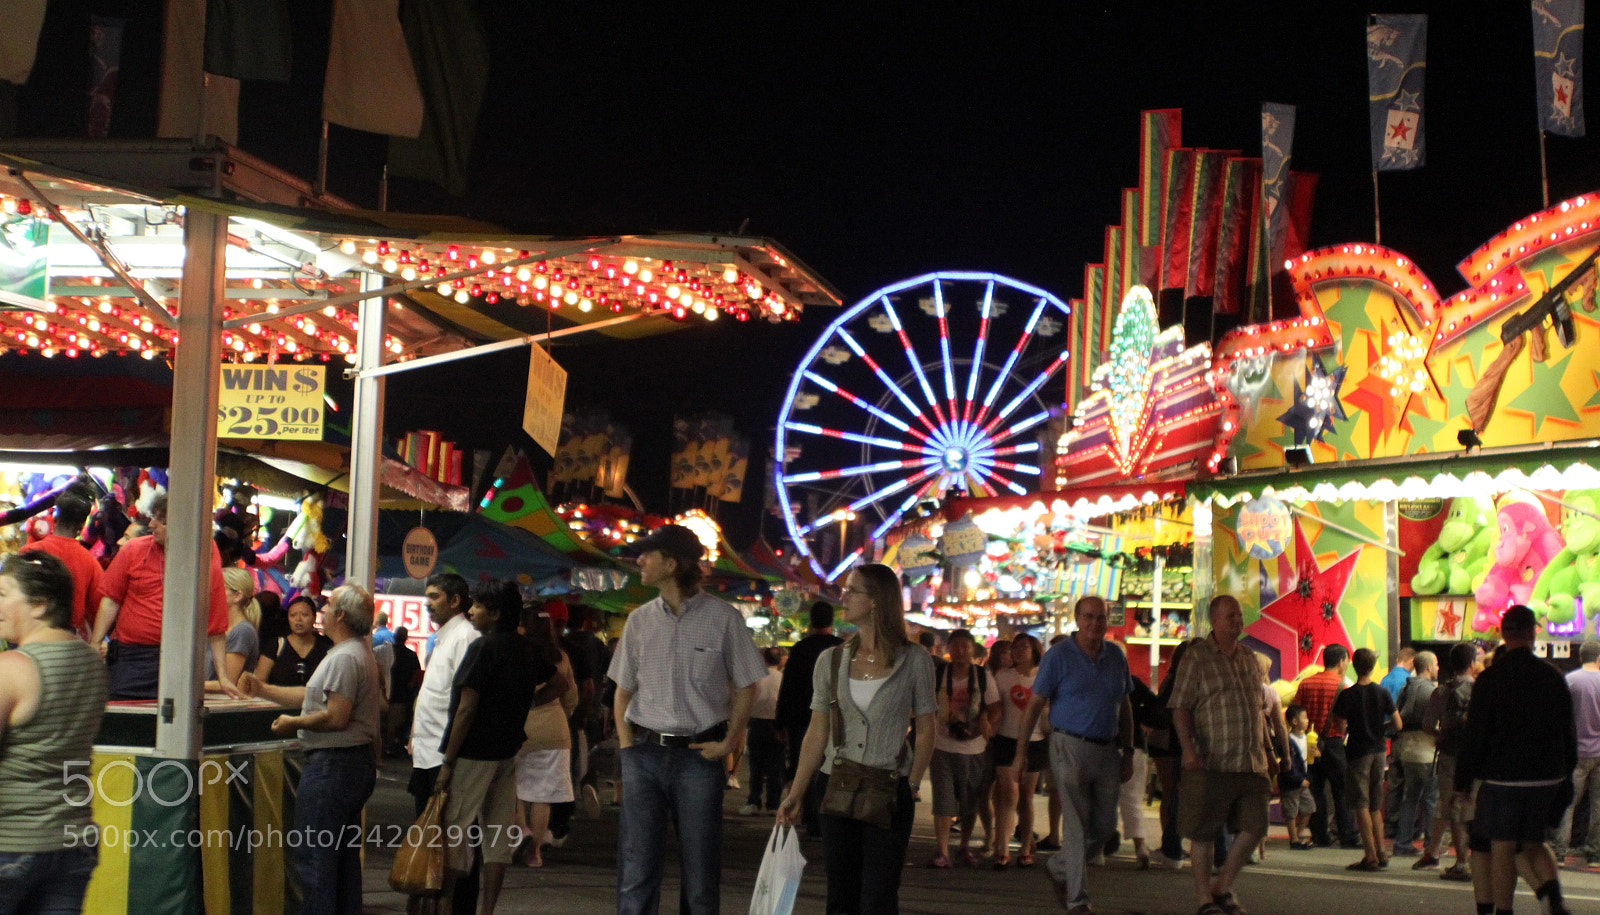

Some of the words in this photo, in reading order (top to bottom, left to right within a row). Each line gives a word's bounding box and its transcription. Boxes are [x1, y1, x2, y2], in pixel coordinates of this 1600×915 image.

[222, 368, 288, 391] WIN
[292, 367, 319, 397] $
[246, 394, 265, 404] UP
[268, 395, 286, 404] TO
[282, 426, 299, 434] Per
[302, 426, 320, 434] Bet
[1240, 511, 1289, 528] SHOOT
[406, 544, 435, 556] BIRTHDAY
[410, 556, 429, 566] GAME
[402, 603, 418, 630] 5
